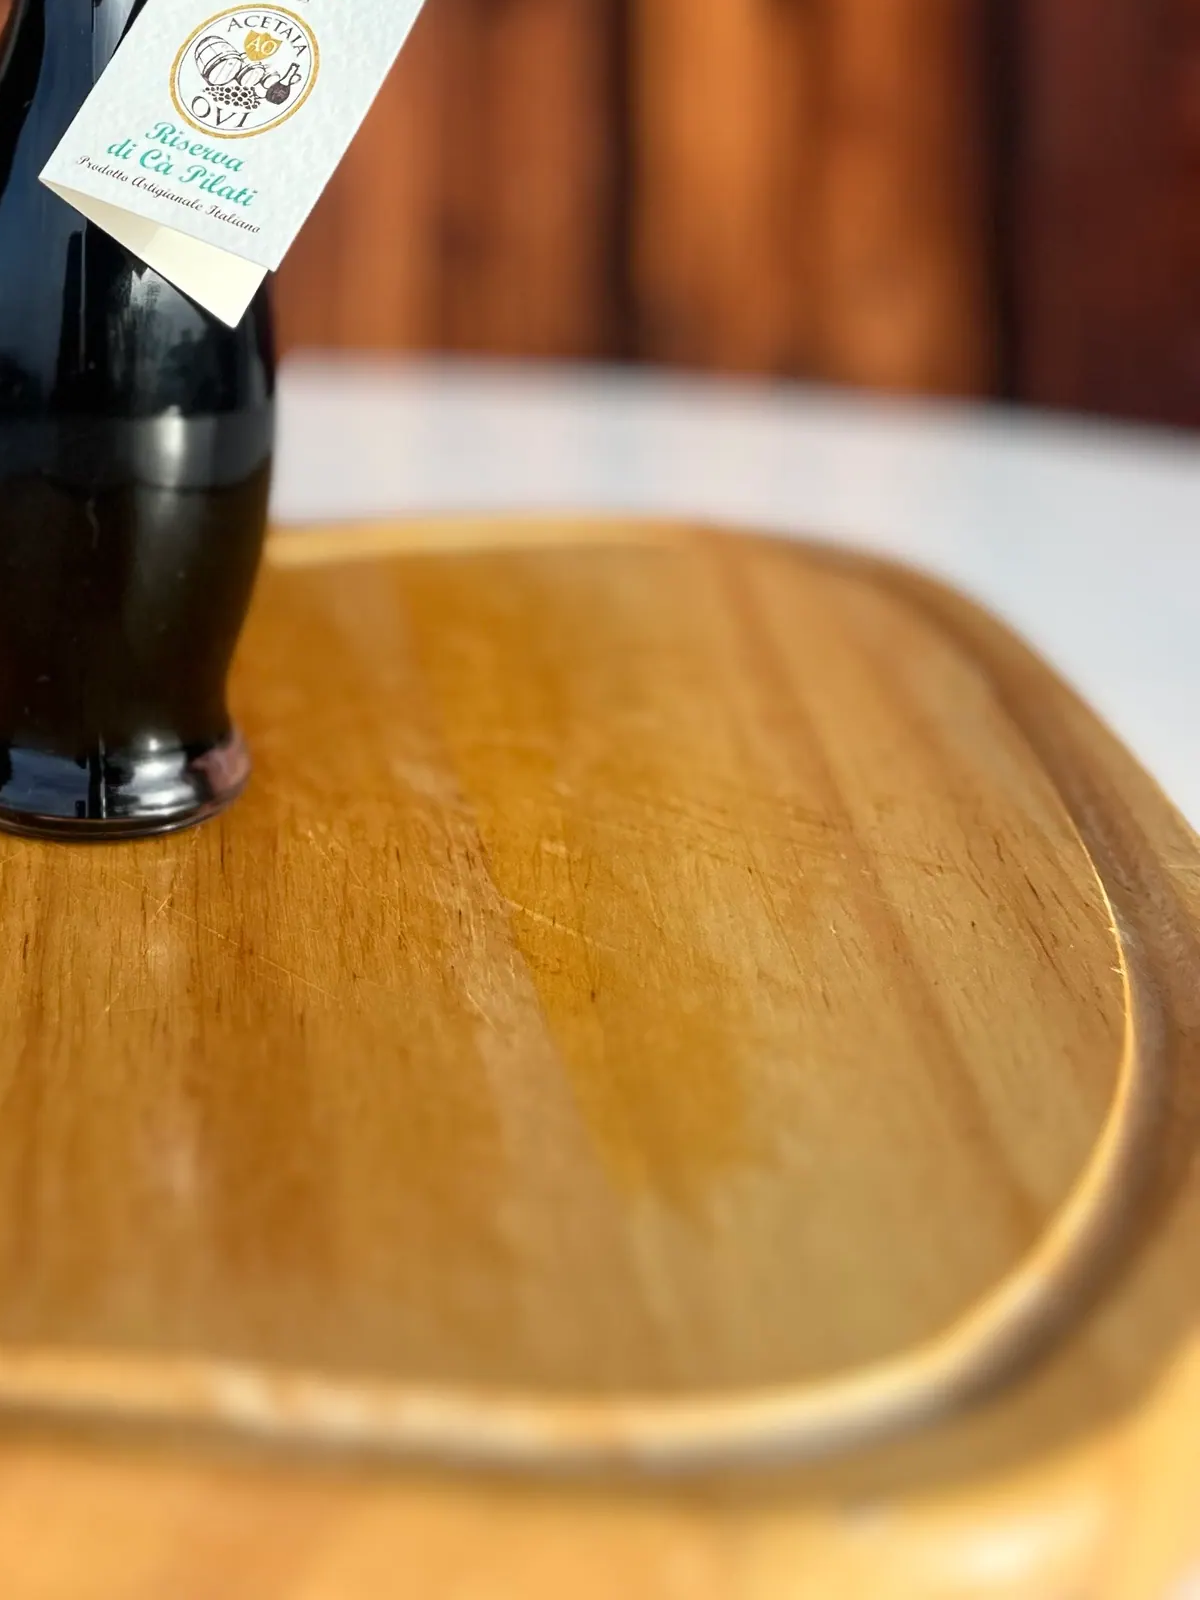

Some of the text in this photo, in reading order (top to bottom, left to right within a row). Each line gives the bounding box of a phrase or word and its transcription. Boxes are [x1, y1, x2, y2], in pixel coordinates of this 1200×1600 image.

[227, 15, 308, 57] ACETAIA
[246, 37, 277, 56] AO
[191, 95, 250, 128] OVI
[145, 121, 247, 173] Riserva
[75, 155, 261, 234] Prodotto Artigianale Italiano
[107, 138, 259, 207] di Cà Pilati
